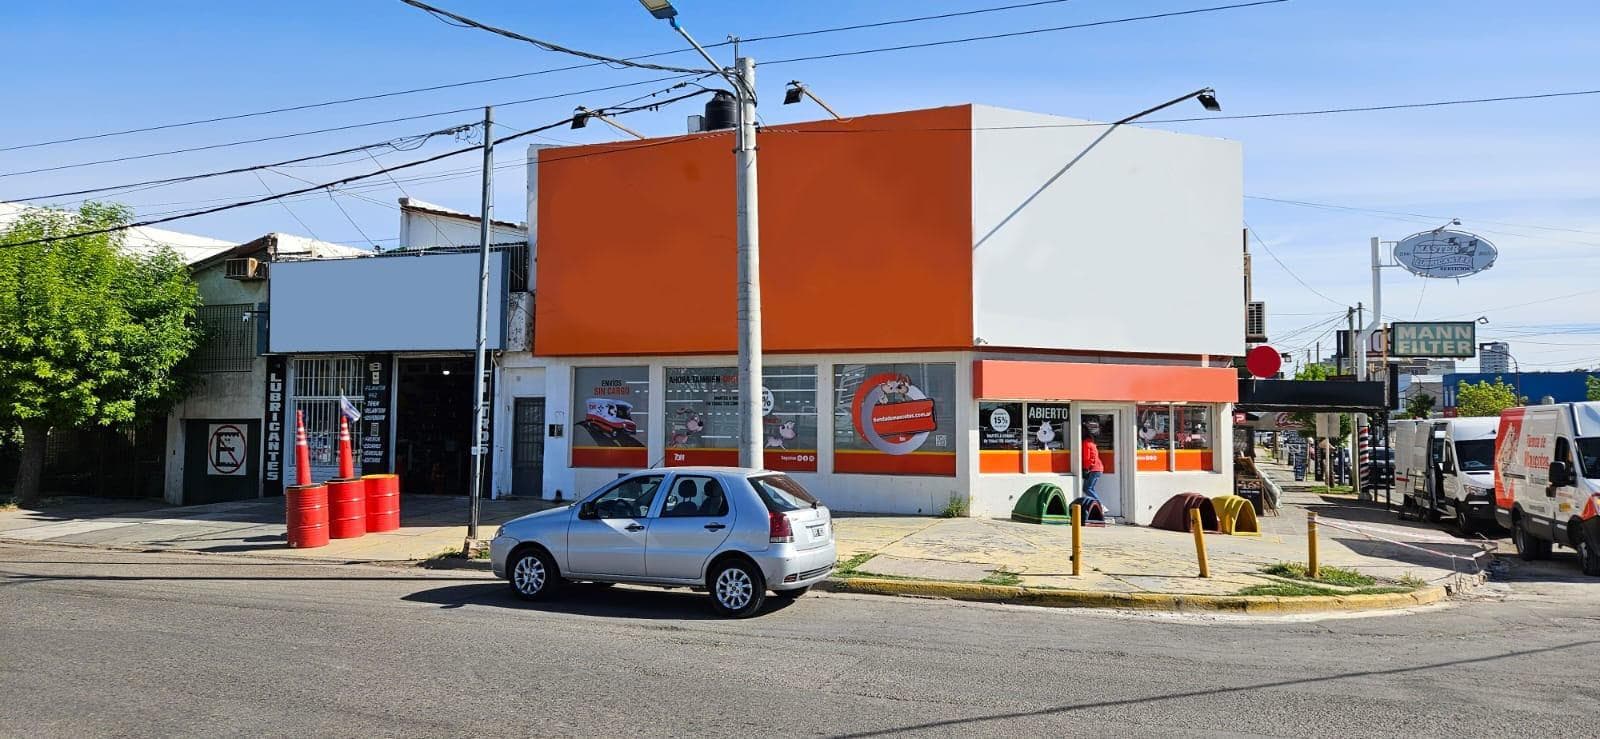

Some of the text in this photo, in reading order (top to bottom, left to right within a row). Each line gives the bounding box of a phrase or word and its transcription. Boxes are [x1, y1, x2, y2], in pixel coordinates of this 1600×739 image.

[1397, 326, 1472, 340] MANN
[1398, 341, 1472, 354] FILTER
[993, 416, 1008, 424] 15%
[1028, 406, 1068, 420] ABIERTO
[266, 372, 282, 481] LUBRICANTES
